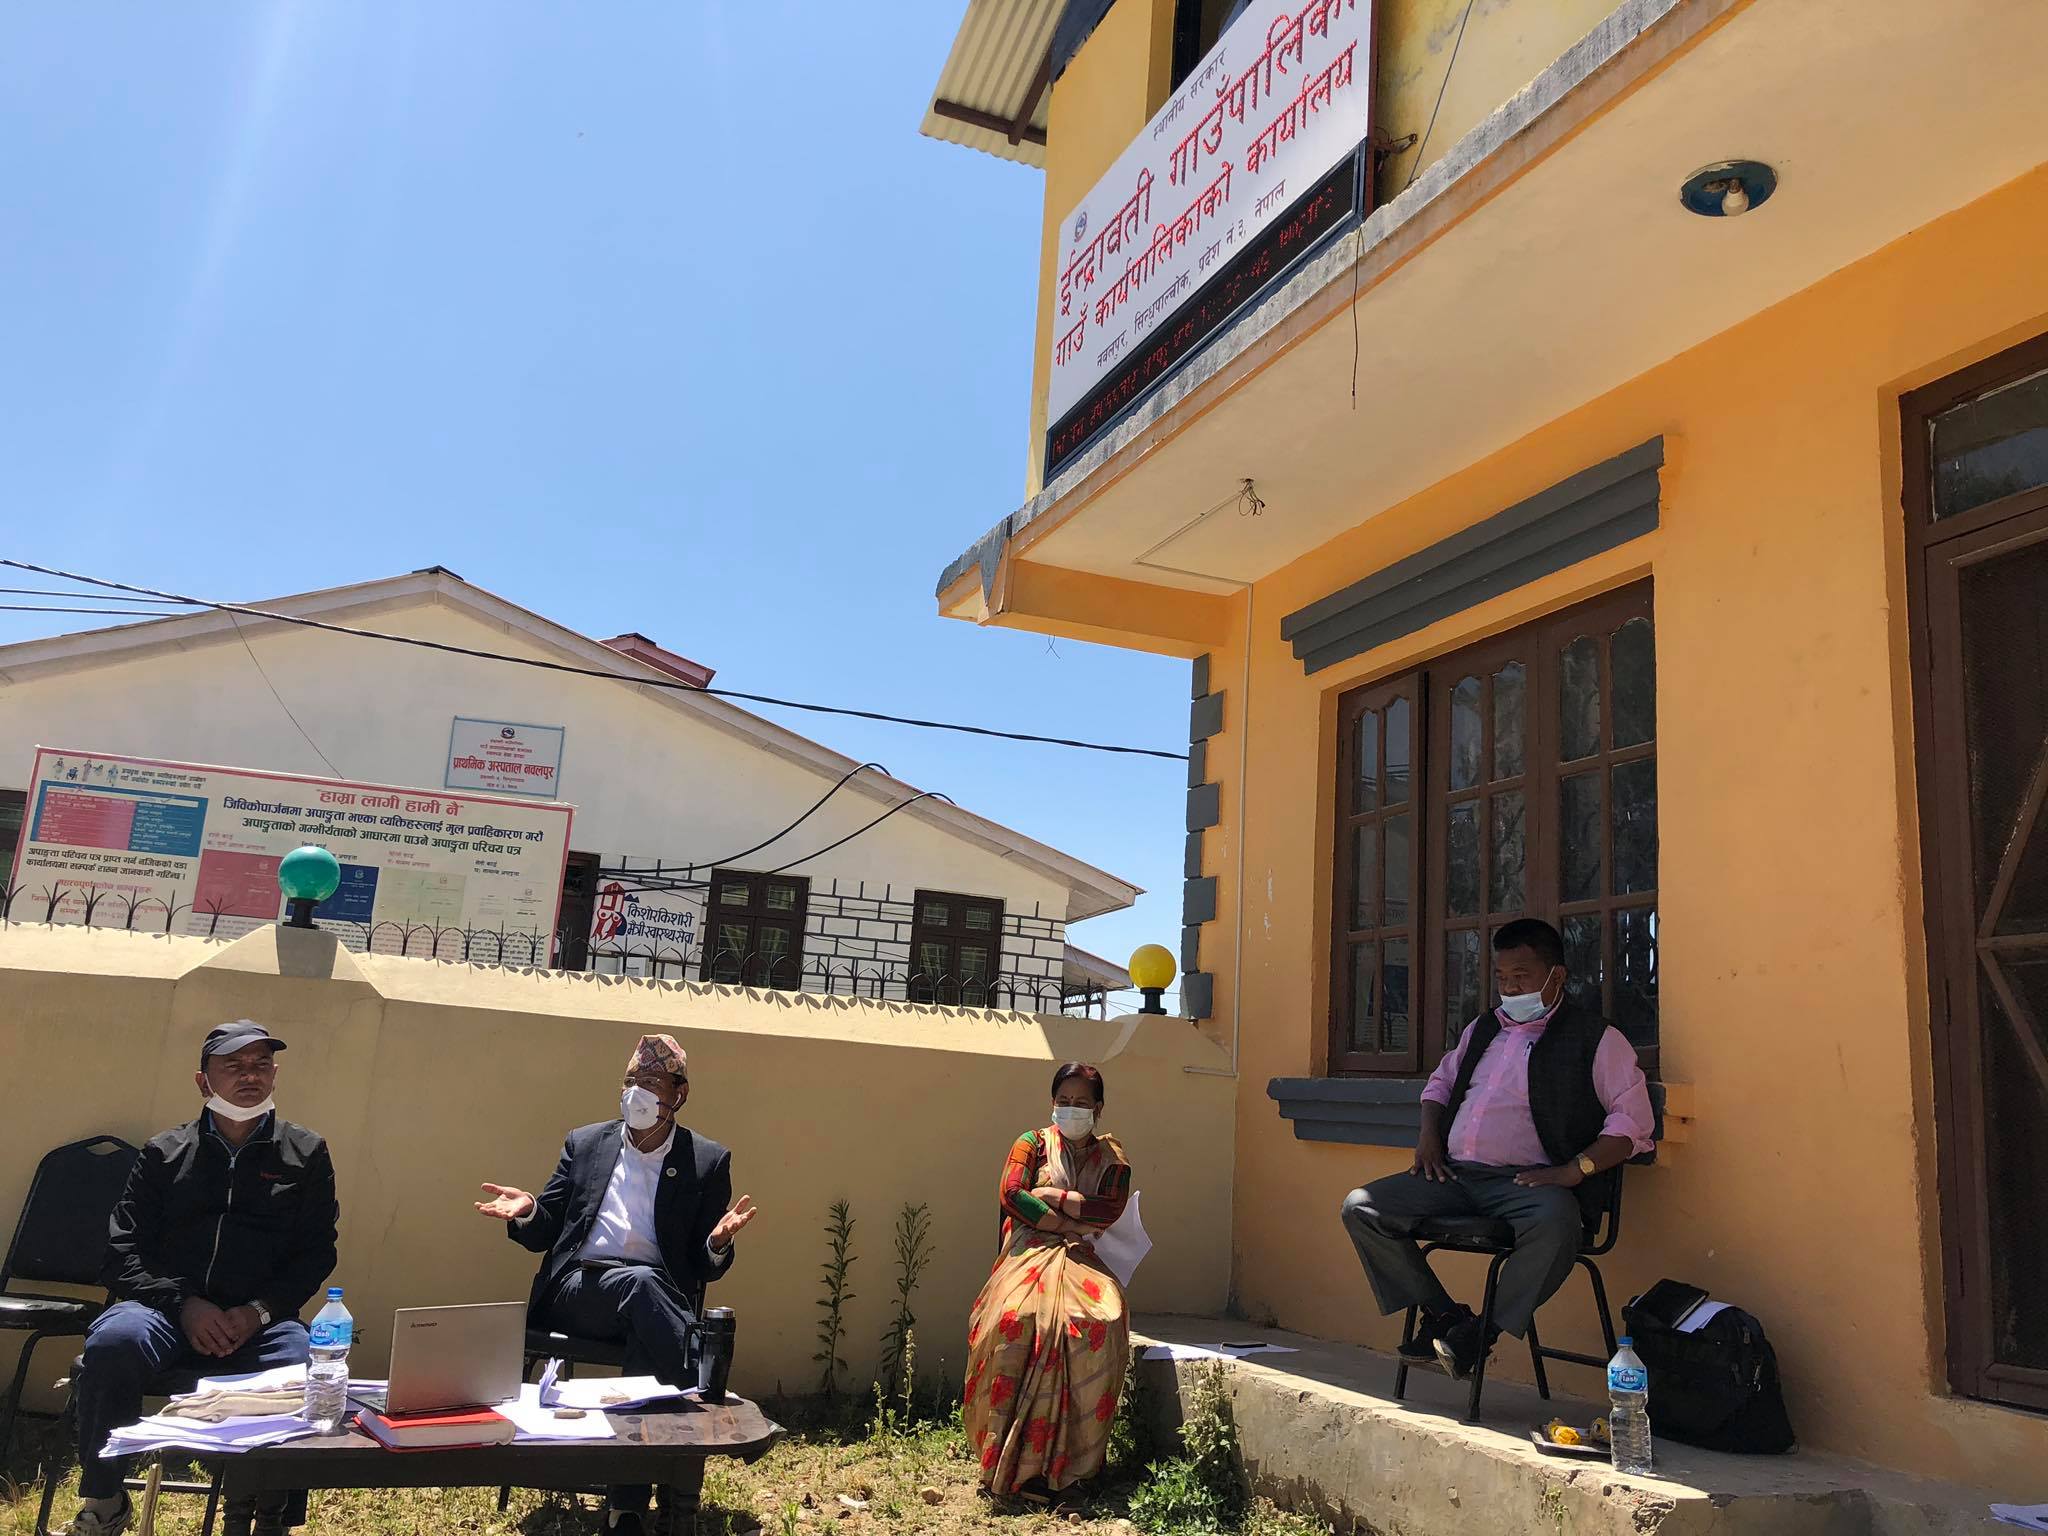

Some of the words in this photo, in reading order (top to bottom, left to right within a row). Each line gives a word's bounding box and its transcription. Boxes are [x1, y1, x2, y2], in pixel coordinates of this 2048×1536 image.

[1153, 94, 1187, 141] स्थानीय
[1190, 47, 1228, 99] सरकार
[1168, 0, 1356, 186] गाउँपालिक
[1055, 302, 1088, 367] गाउँ
[1094, 161, 1235, 328] कार्यपालिकाको
[1246, 38, 1358, 176] कार्यालय
[1198, 239, 1222, 275] प्रदेश
[1254, 178, 1286, 218] नेपाल
[488, 760, 522, 774] अस्पताल
[524, 763, 555, 780] नवलपुर
[361, 795, 400, 810] लागी
[405, 800, 441, 815] हामी
[348, 813, 377, 825] भएका
[445, 823, 465, 836] मुल
[404, 834, 429, 846] पाउने
[472, 840, 504, 854] परिचय
[506, 845, 522, 856] पत्र
[675, 928, 695, 945] सेवा
